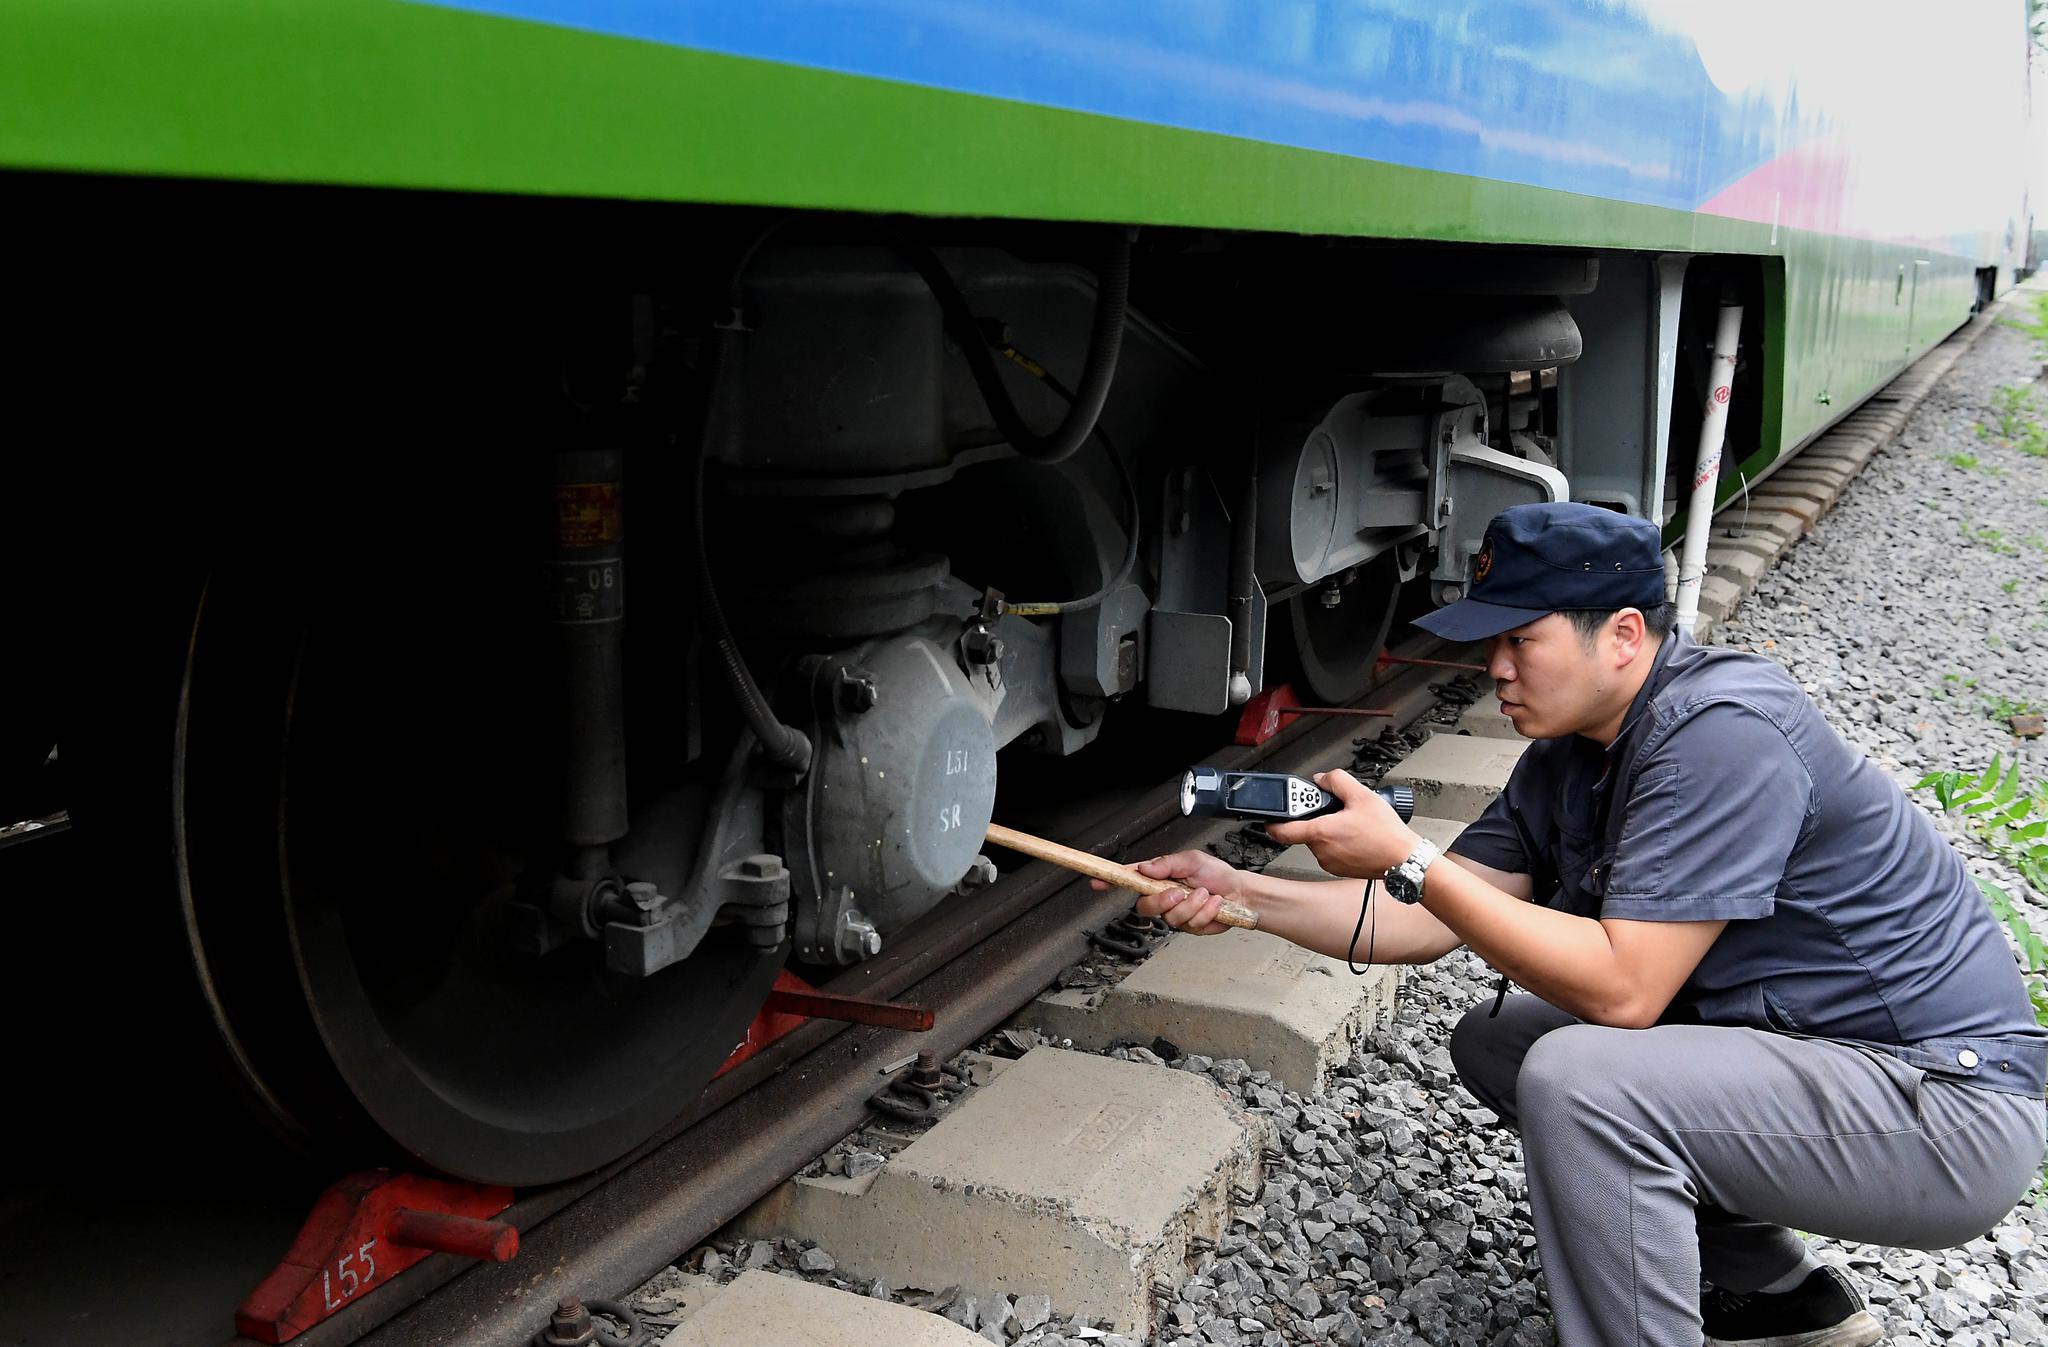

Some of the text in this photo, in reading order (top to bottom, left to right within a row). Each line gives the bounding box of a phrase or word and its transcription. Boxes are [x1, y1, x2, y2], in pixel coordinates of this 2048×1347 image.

[946, 750, 968, 775] L51
[940, 804, 961, 832] SR
[322, 1238, 377, 1311] L55
